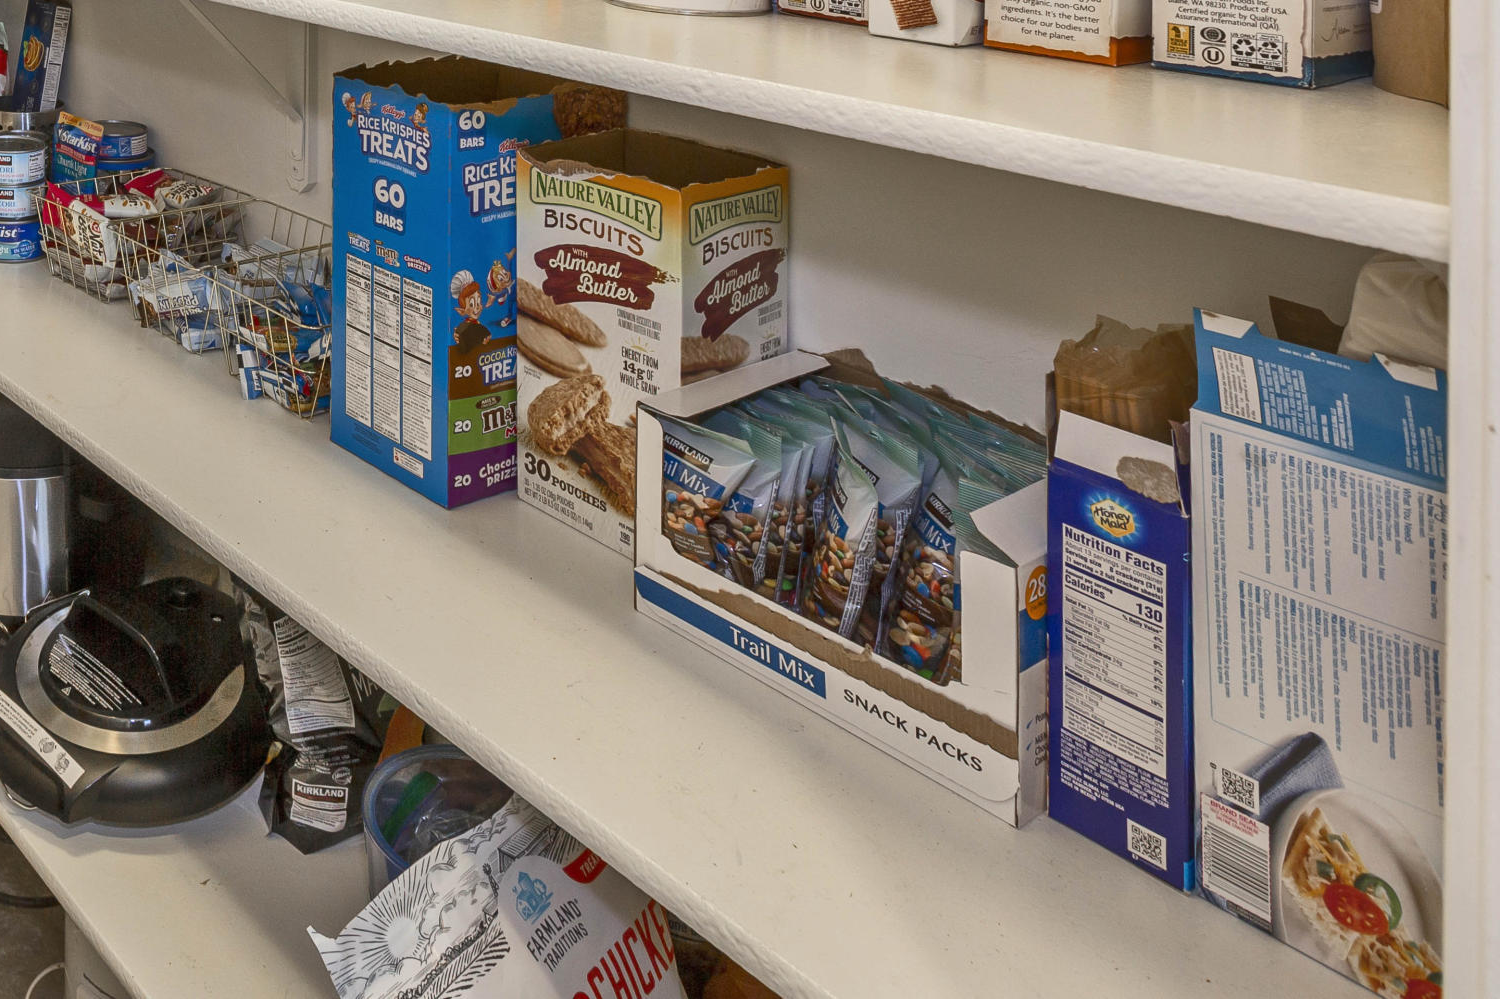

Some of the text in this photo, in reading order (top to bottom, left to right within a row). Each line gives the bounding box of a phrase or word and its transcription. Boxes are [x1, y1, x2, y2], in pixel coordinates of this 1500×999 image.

[357, 114, 431, 149] RICE KRISPIES
[458, 110, 486, 130] 60
[359, 129, 428, 172] TREATS
[459, 136, 485, 149] BARS
[465, 161, 498, 185] RICE
[374, 178, 405, 210] 60
[536, 171, 657, 233] NATURE VALLEY
[375, 210, 404, 232] BARS
[694, 189, 780, 239] NATURE VALLEY
[544, 209, 645, 256] BISCUITS
[702, 227, 774, 265] BISCUITS
[549, 250, 623, 279] Almond
[572, 247, 588, 259] WITH
[577, 273, 638, 304] Butter
[707, 263, 761, 306] Almond
[729, 282, 771, 315] Butter
[454, 351, 507, 379] 20 COCOA
[454, 420, 472, 434] 20
[664, 433, 711, 466] KIRKLAND
[454, 474, 472, 488] 20
[524, 452, 551, 482] 30
[551, 474, 608, 513] POUCHES
[679, 468, 710, 496] Mix
[1093, 505, 1131, 523] Honey
[1100, 516, 1128, 531] Maid
[928, 527, 950, 552] Mix
[1065, 526, 1165, 577] Nutrition Facts
[1027, 574, 1047, 603] 28
[1065, 573, 1164, 624] Calories 130
[729, 626, 984, 772] Trail Mix SNACK PACKS
[296, 783, 345, 799] KIRKLAND
[526, 898, 583, 962] FARMLAND
[543, 922, 589, 973] TRADITIONS
